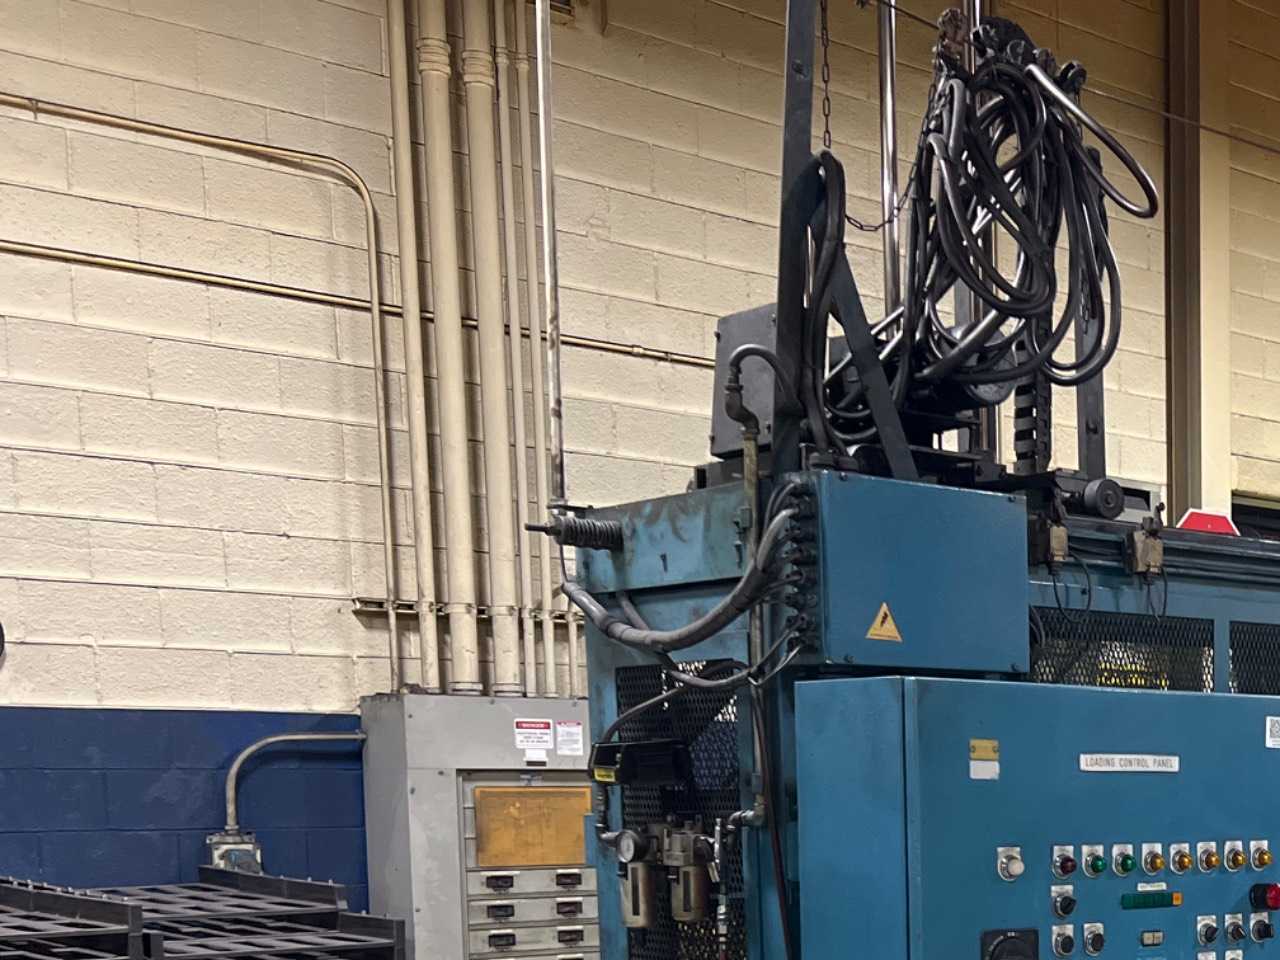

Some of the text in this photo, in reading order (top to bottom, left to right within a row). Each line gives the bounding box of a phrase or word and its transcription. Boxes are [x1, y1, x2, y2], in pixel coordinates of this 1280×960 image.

[1085, 758, 1174, 769] LOADING CONTROL PANEL
